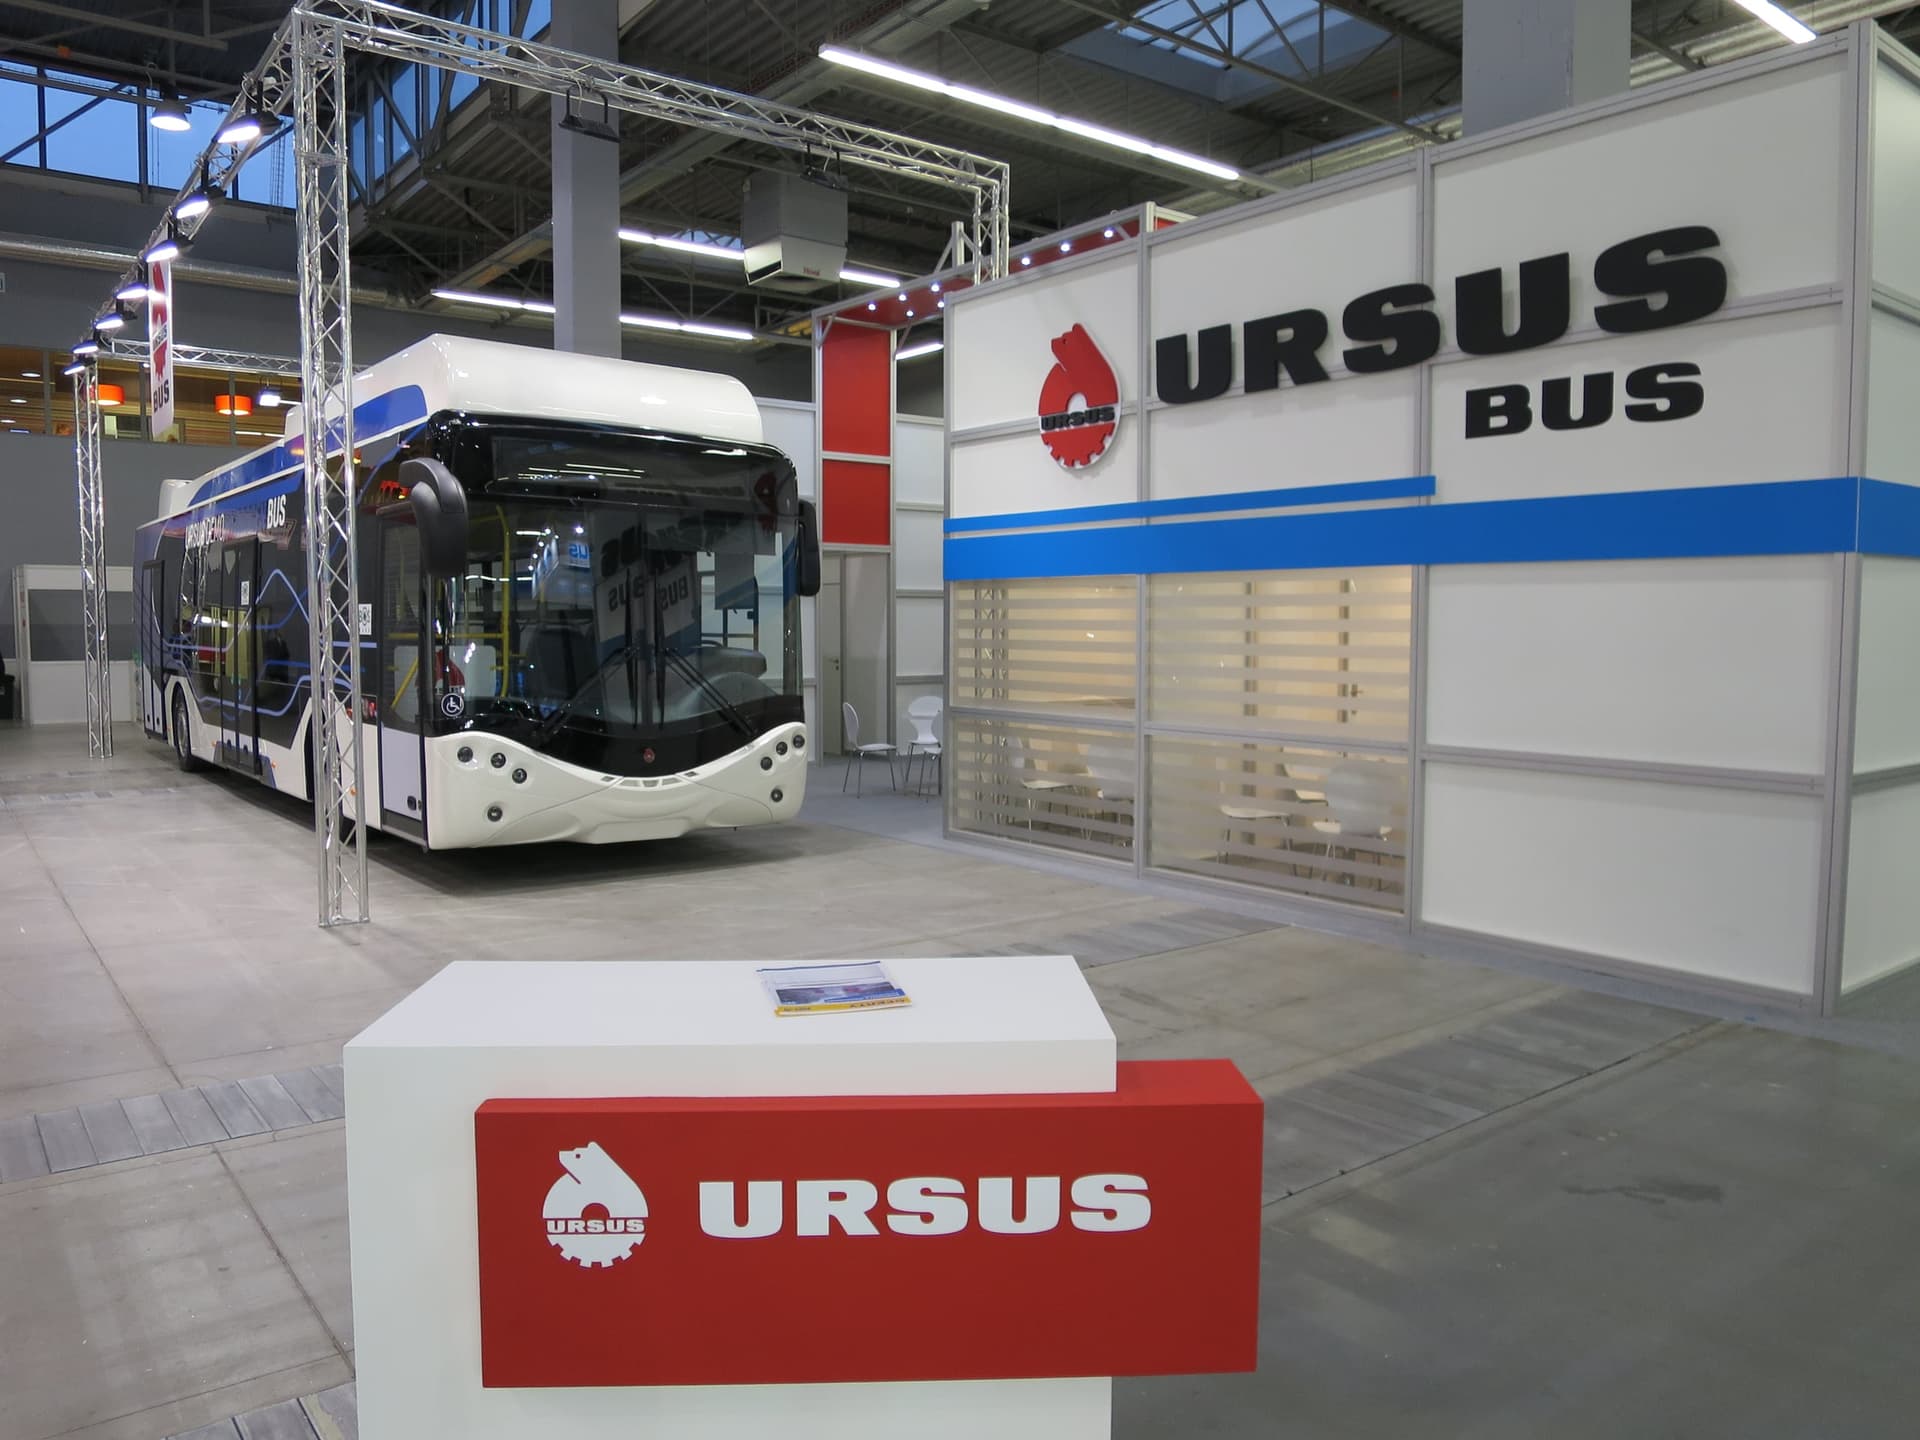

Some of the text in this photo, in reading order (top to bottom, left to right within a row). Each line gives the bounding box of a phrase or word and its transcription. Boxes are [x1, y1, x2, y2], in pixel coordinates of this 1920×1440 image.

[1156, 226, 1729, 405] URSUS
[153, 379, 170, 413] BUS
[1465, 362, 1705, 439] BUS
[1041, 406, 1116, 432] URSUS
[267, 494, 287, 529] BUS
[699, 1173, 1152, 1240] URSUS
[546, 1219, 645, 1234] URSUS
